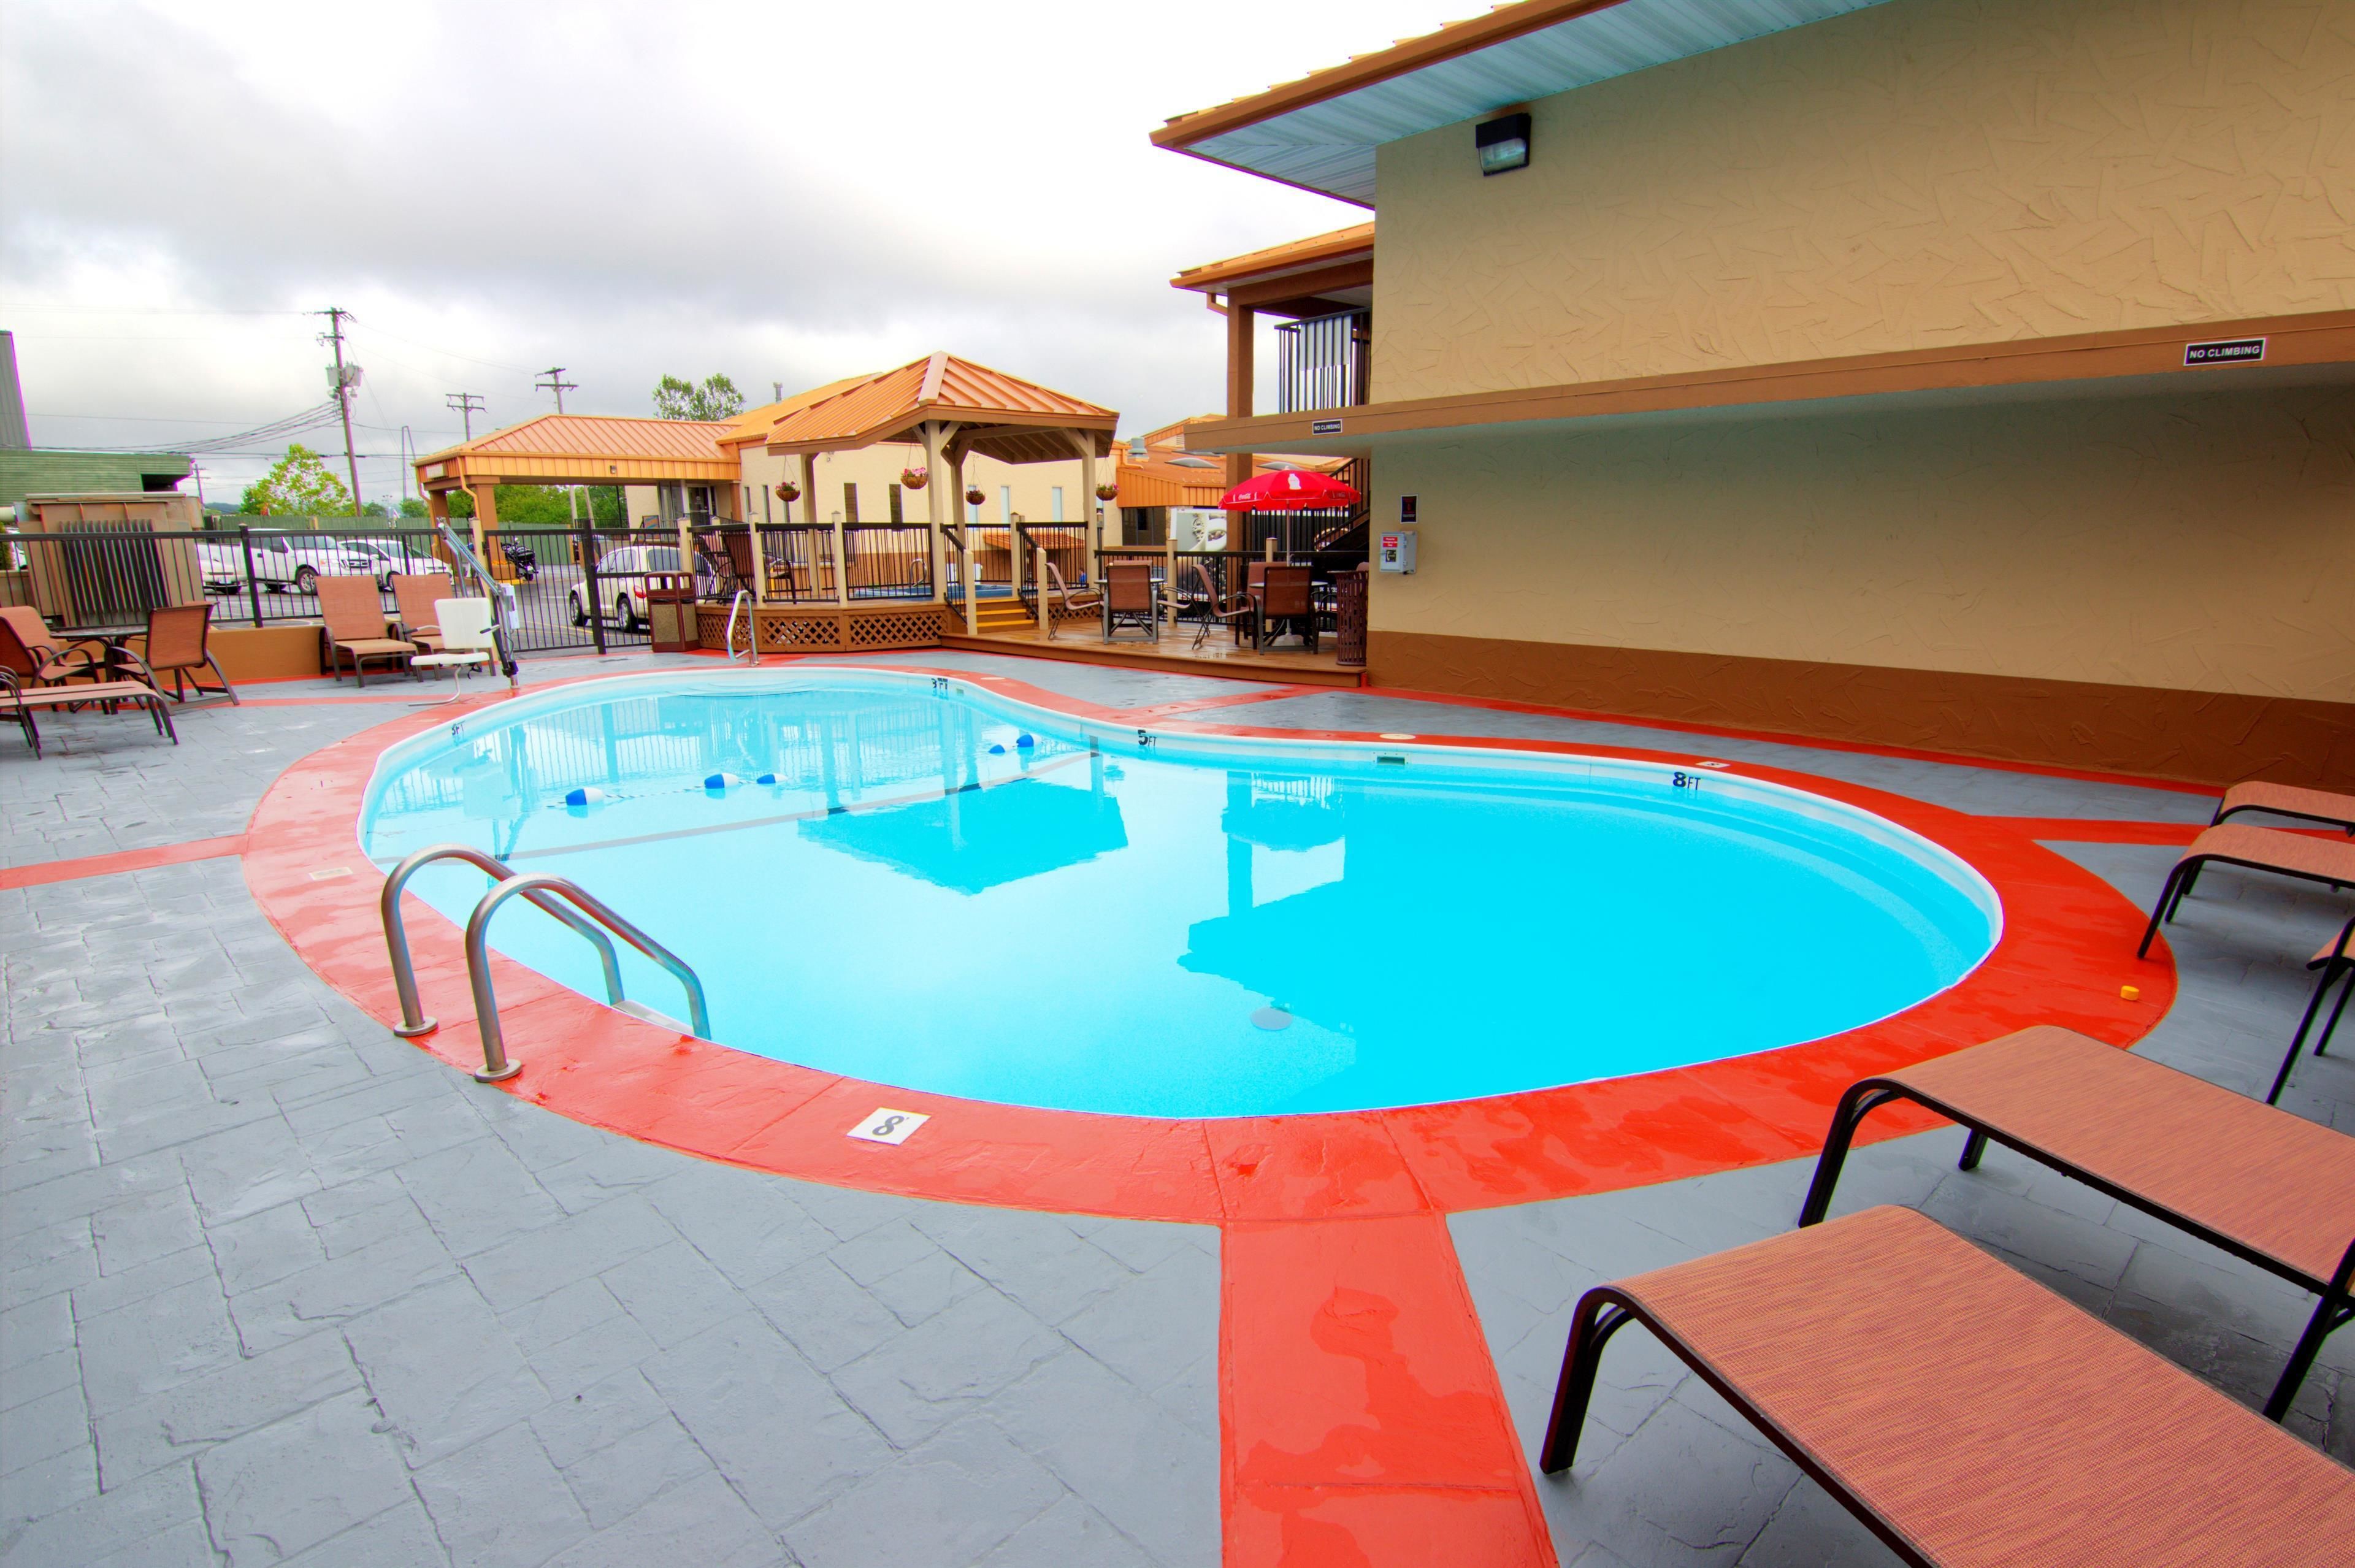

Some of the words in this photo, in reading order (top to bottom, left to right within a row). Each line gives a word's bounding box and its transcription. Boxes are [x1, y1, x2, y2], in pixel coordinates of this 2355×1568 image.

[2189, 350, 2205, 359] NO
[2207, 345, 2261, 358] CLIMBING
[1138, 729, 1157, 746] 5FT
[1672, 771, 1701, 790] 8FT
